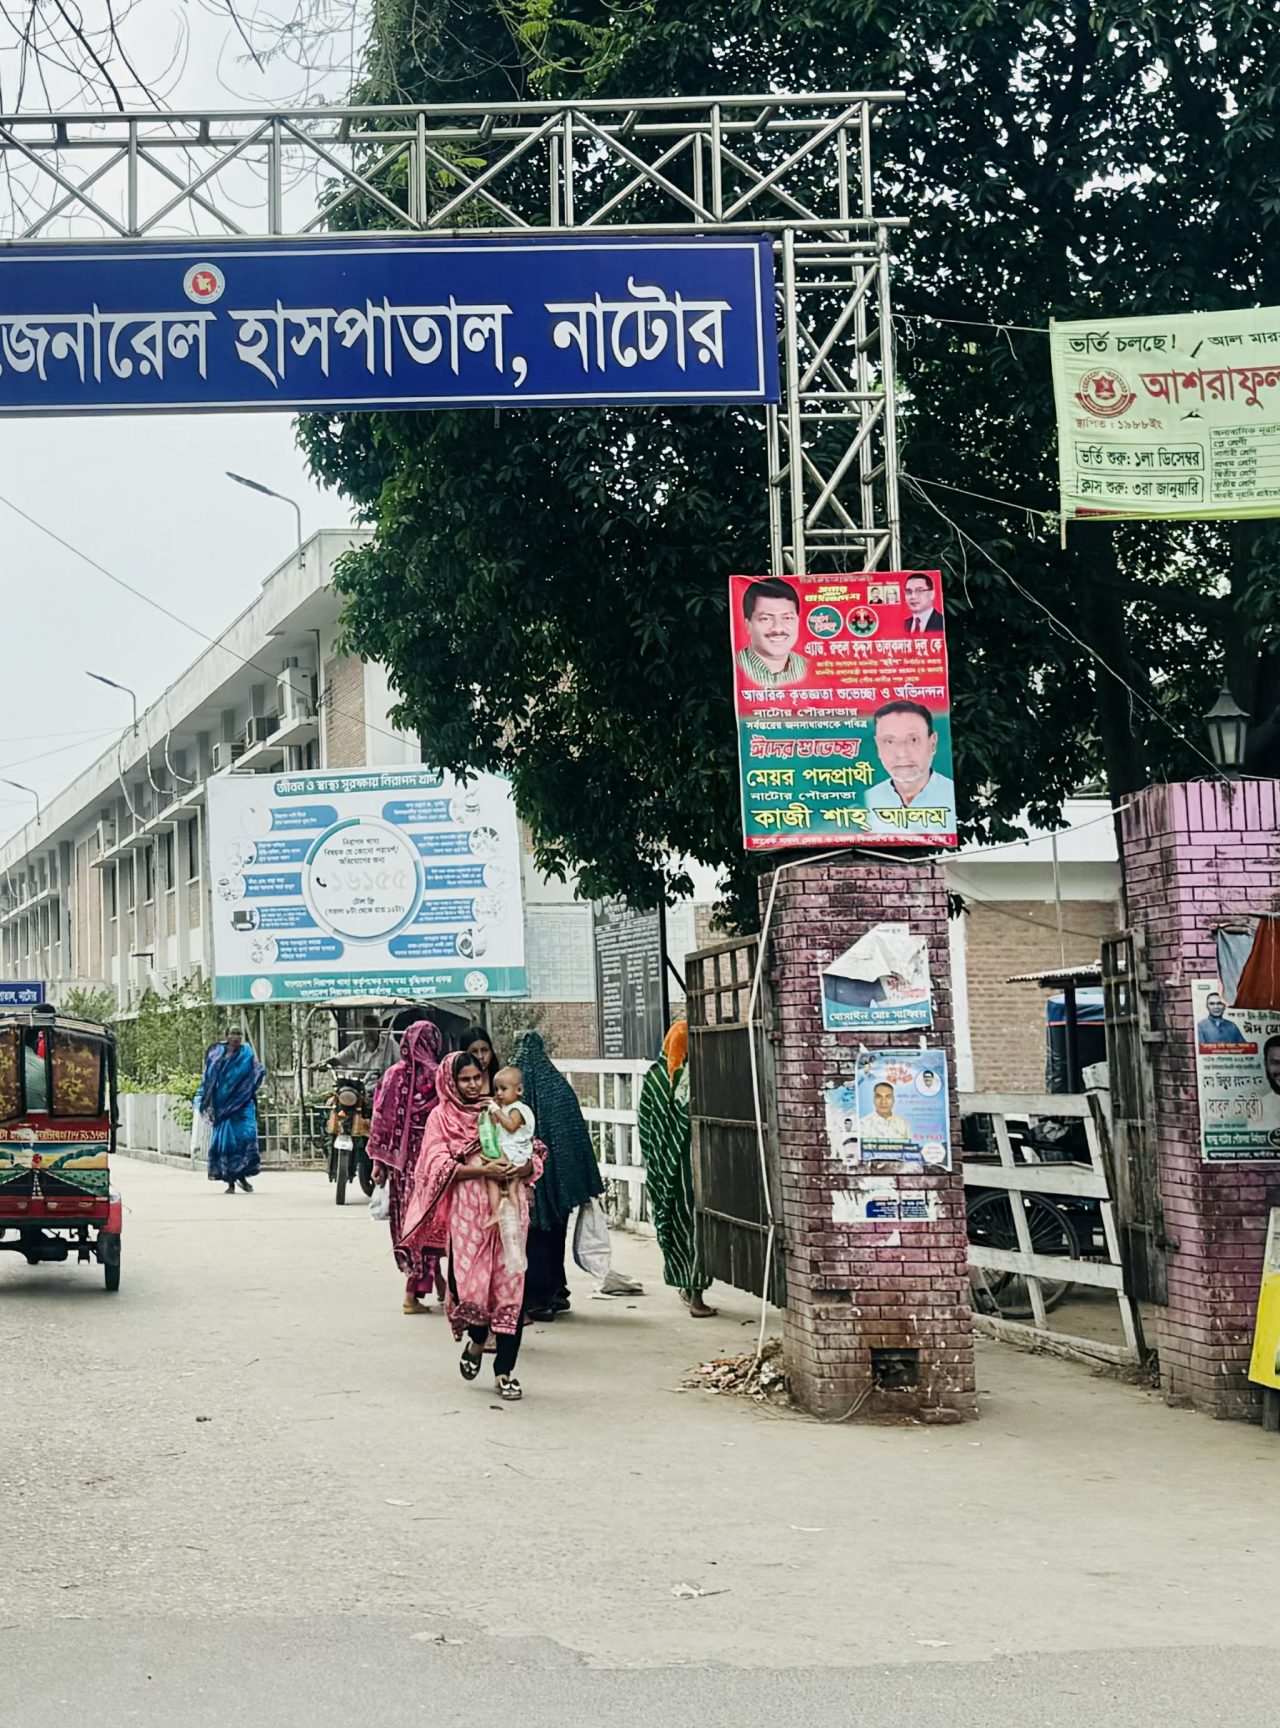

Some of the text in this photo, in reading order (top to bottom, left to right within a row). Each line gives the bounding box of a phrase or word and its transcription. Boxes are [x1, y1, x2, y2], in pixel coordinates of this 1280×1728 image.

[229, 297, 528, 389] হাসপাতাল,
[545, 275, 733, 371] নাটোর
[1068, 331, 1176, 354] ভর্তি চলছে!
[1207, 331, 1280, 347] আল মার
[1075, 417, 1106, 430] স্থাপিত
[1079, 445, 1104, 465] ভর্তি
[1135, 451, 1154, 467] ১লা
[1157, 446, 1201, 467] ডিসেম্বর
[1081, 478, 1102, 494] ক্লাস
[1132, 482, 1153, 496] ৩রা
[1156, 477, 1199, 498] জানুয়ারি
[874, 639, 913, 658] তালুকদার
[930, 638, 943, 654] কে
[741, 682, 946, 706] আন্তরিক কৃতজ্ঞতা শুভেচ্ছা ও অভিনন্দন
[752, 706, 858, 718] নাটোর পৌরসভার
[745, 717, 868, 730] সর্বস্তরের জনসাধারণকে পবিত্র
[750, 732, 862, 760] ঈদের শুভেচ্ছা
[276, 781, 305, 794] জীবন
[306, 780, 314, 791] ও
[317, 780, 340, 792] স্বাস্থ্য
[341, 777, 380, 793] সুরক্ষায়
[380, 773, 417, 788] নিরাপদ
[746, 761, 876, 787] মেয়র পদপ্রার্থী
[750, 790, 857, 801] নাটোর পৌরসভা
[751, 802, 951, 831] কাজী শাহ্ আলম
[330, 869, 408, 892] ১৬১৫৫
[1243, 1021, 1262, 1034] ঈদ
